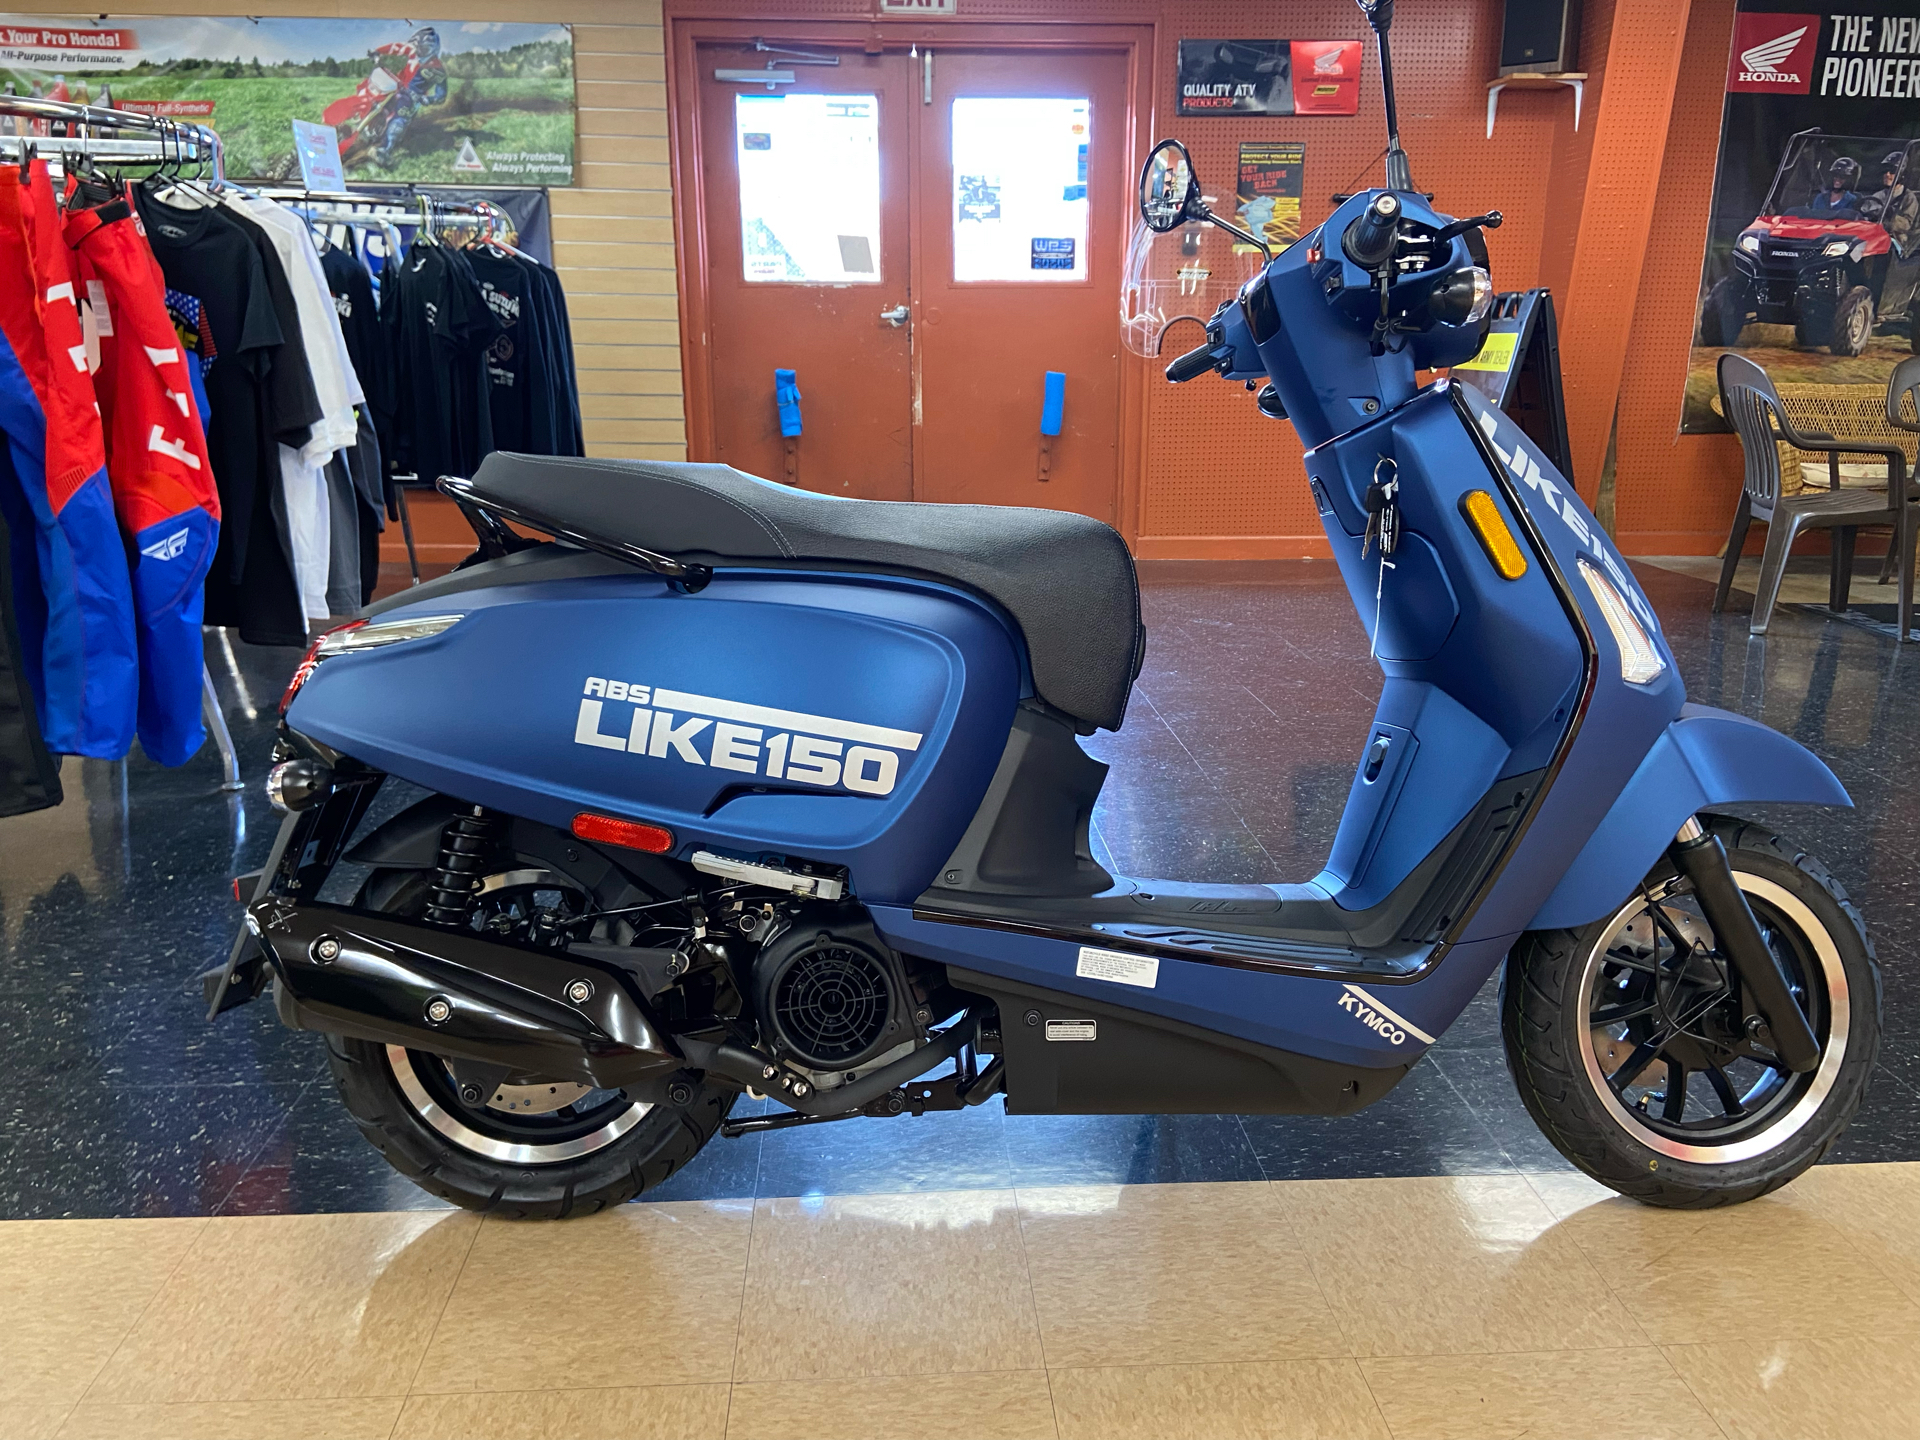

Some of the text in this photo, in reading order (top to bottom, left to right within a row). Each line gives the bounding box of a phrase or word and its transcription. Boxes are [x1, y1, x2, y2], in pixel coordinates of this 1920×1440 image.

[7, 29, 38, 44] Your
[42, 31, 67, 45] Pro
[69, 32, 120, 47] Honda!
[1830, 15, 1874, 52] THE
[1, 50, 125, 64] All-Purpose Performance.
[1738, 71, 1801, 83] HONDA
[1820, 57, 1920, 99] PIONEER
[1183, 83, 1257, 97] QUALITY ATV
[121, 103, 210, 114] Ultimate Full-Synthetic
[1182, 97, 1234, 108] PRODUCTS
[486, 151, 566, 164] Always Protecting
[492, 162, 524, 175] Always
[526, 163, 573, 176] Performing
[1240, 170, 1287, 182] YOUR RIDE
[1241, 165, 1259, 174] GET
[1253, 179, 1278, 189] BACK
[1771, 250, 1799, 258] HONDA
[583, 676, 651, 705] ABS
[574, 698, 899, 796] LIKE150
[1337, 992, 1406, 1045] KYMCO
